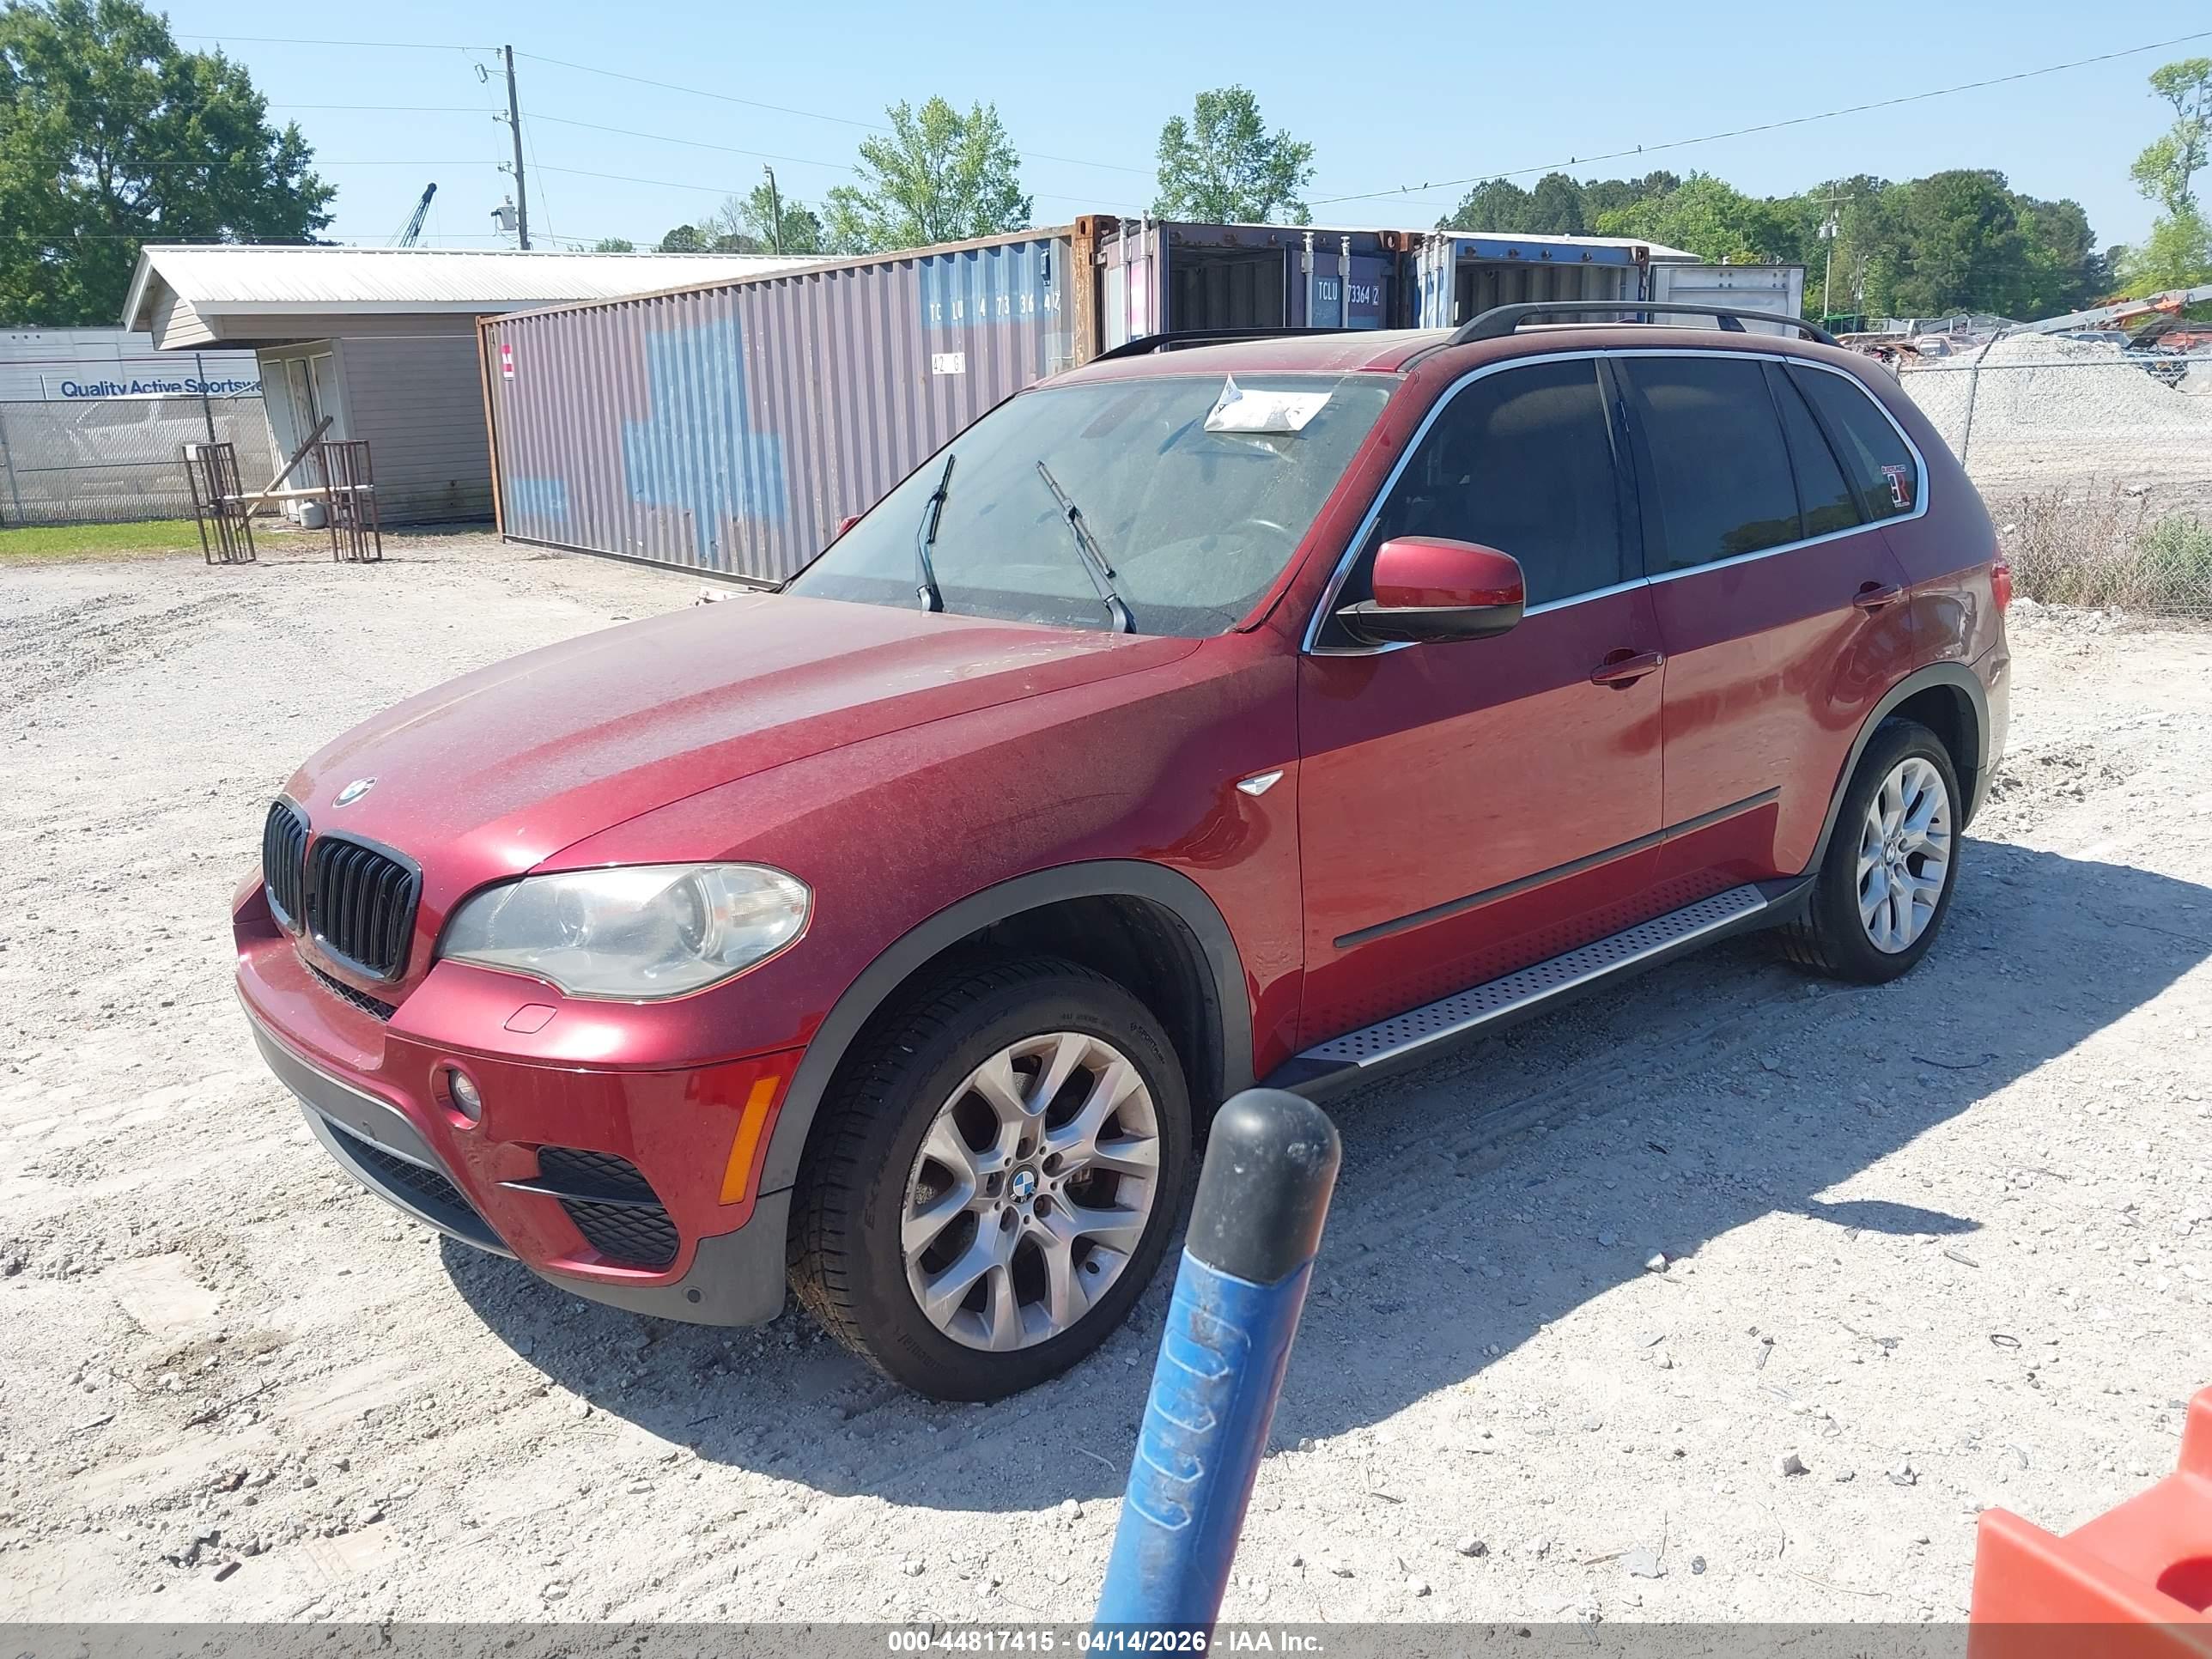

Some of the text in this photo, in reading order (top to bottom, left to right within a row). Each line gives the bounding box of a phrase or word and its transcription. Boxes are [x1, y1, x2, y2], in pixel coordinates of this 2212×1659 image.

[1318, 281, 1379, 304] TCLU 73364 2
[61, 380, 127, 398] Quality
[130, 379, 182, 394] Active
